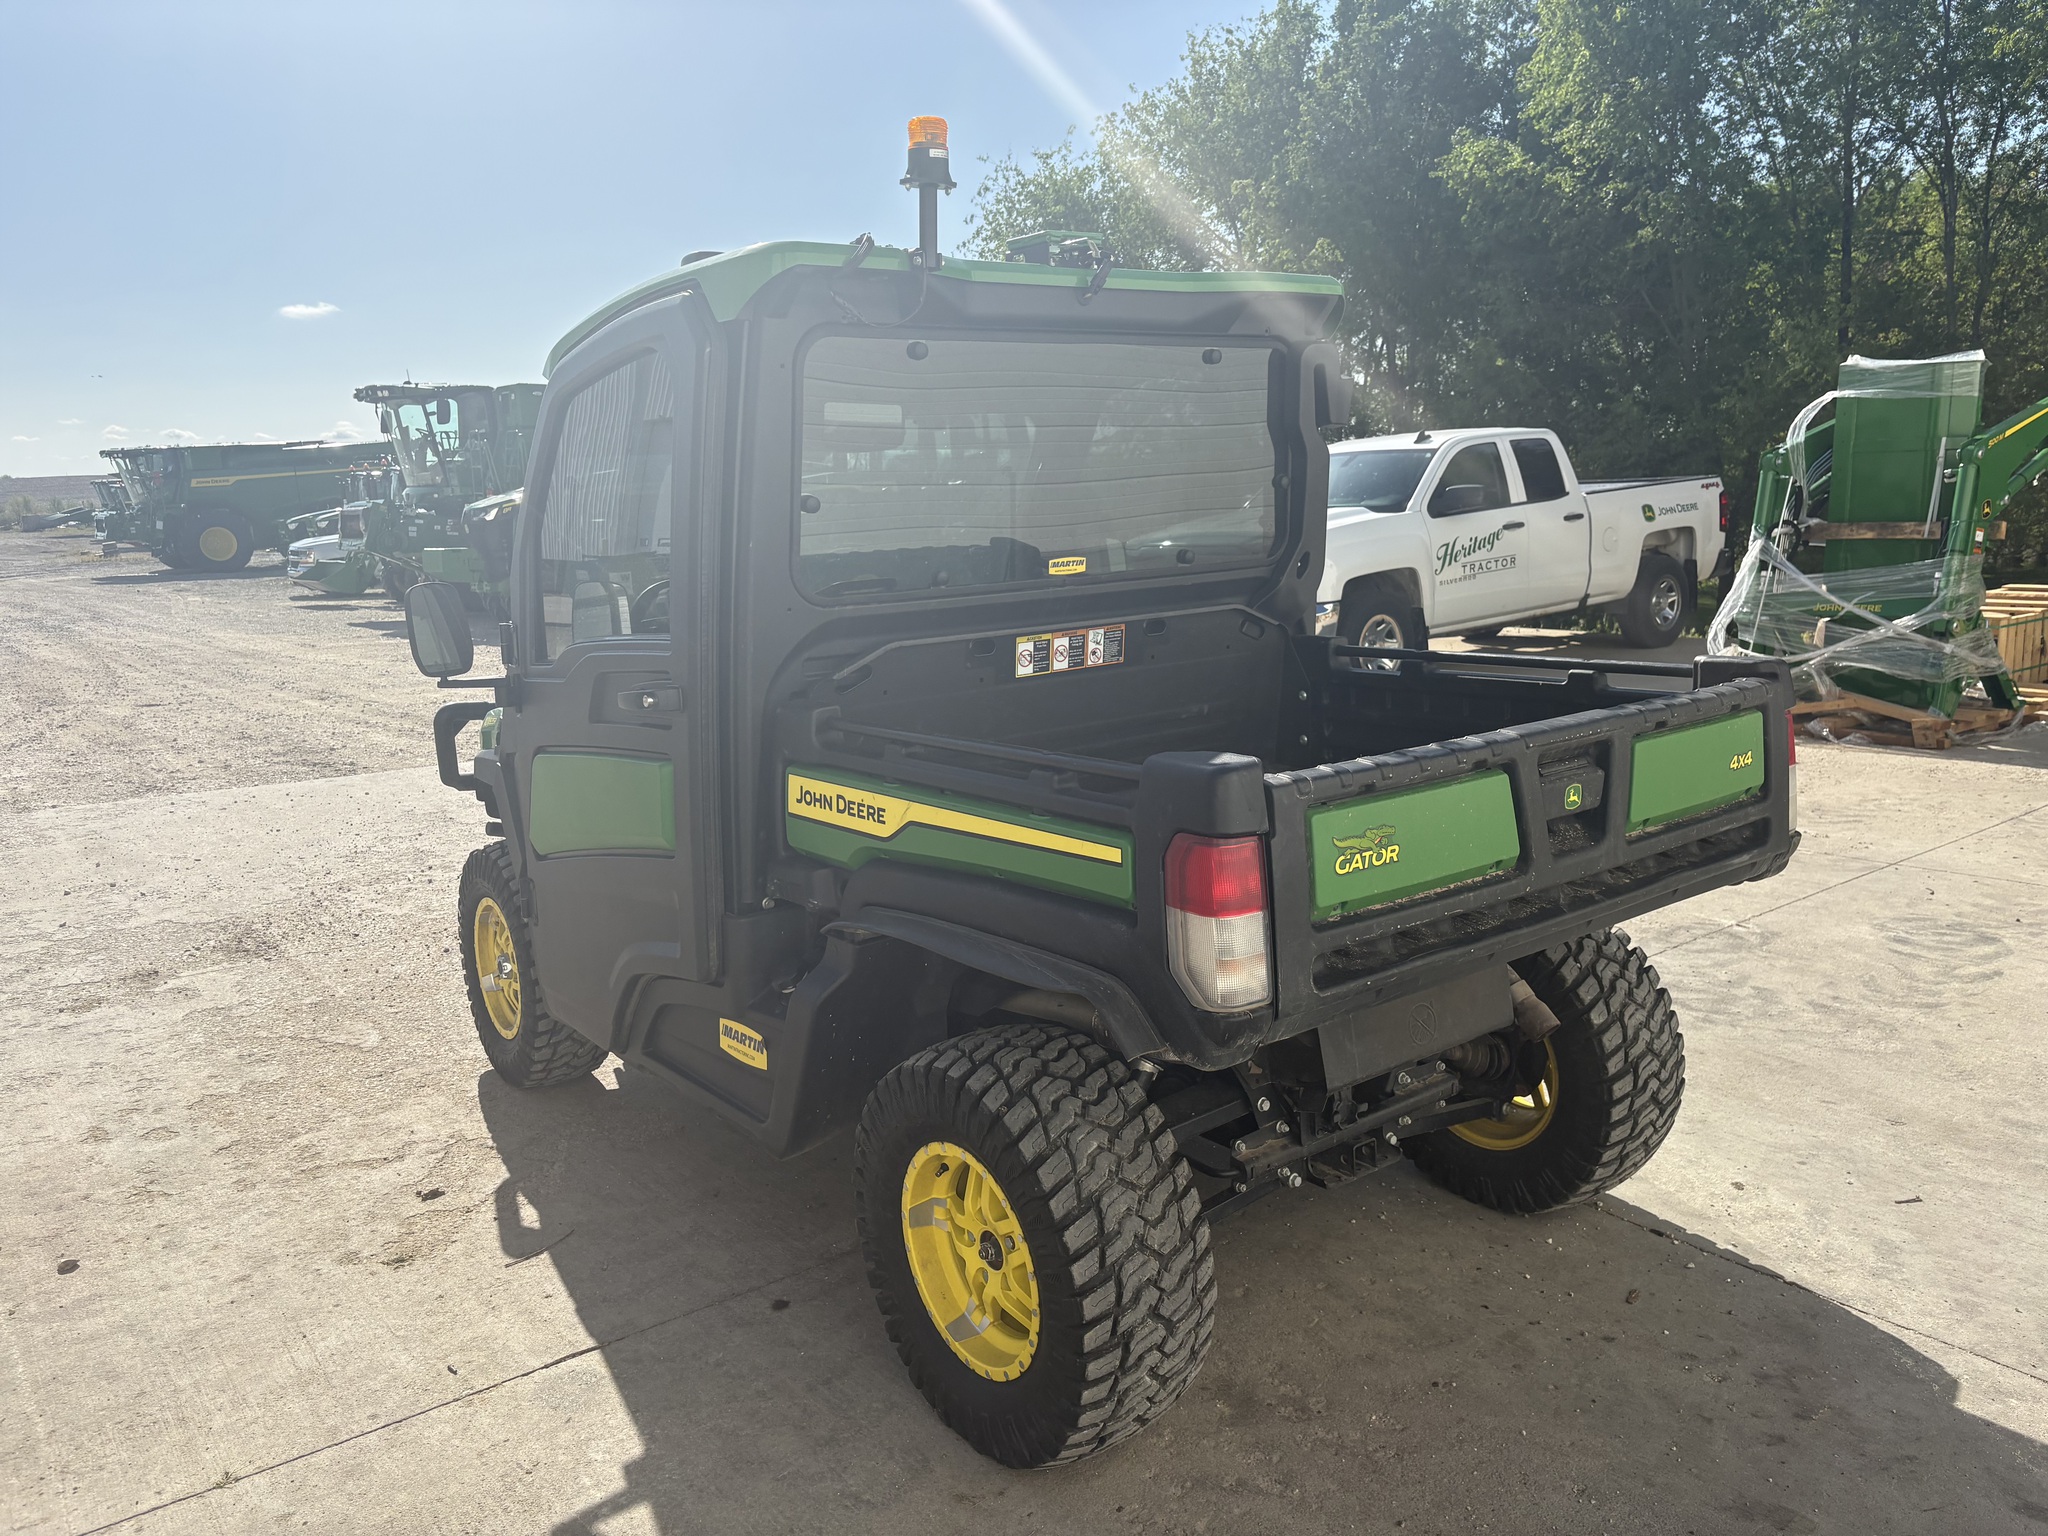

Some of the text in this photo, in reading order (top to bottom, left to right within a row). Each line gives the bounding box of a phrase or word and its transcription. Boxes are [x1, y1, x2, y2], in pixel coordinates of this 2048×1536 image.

[1658, 502, 1699, 516] JOHN DEERE
[1052, 559, 1085, 568] MARTIN
[1435, 528, 1503, 576] Heritage
[1461, 556, 1517, 574] TRACTOR
[1439, 574, 1477, 586] SILVERADO
[796, 785, 886, 825] JOHN DEERE
[1335, 844, 1400, 875] GATOR
[722, 1025, 765, 1055] MARTIN
